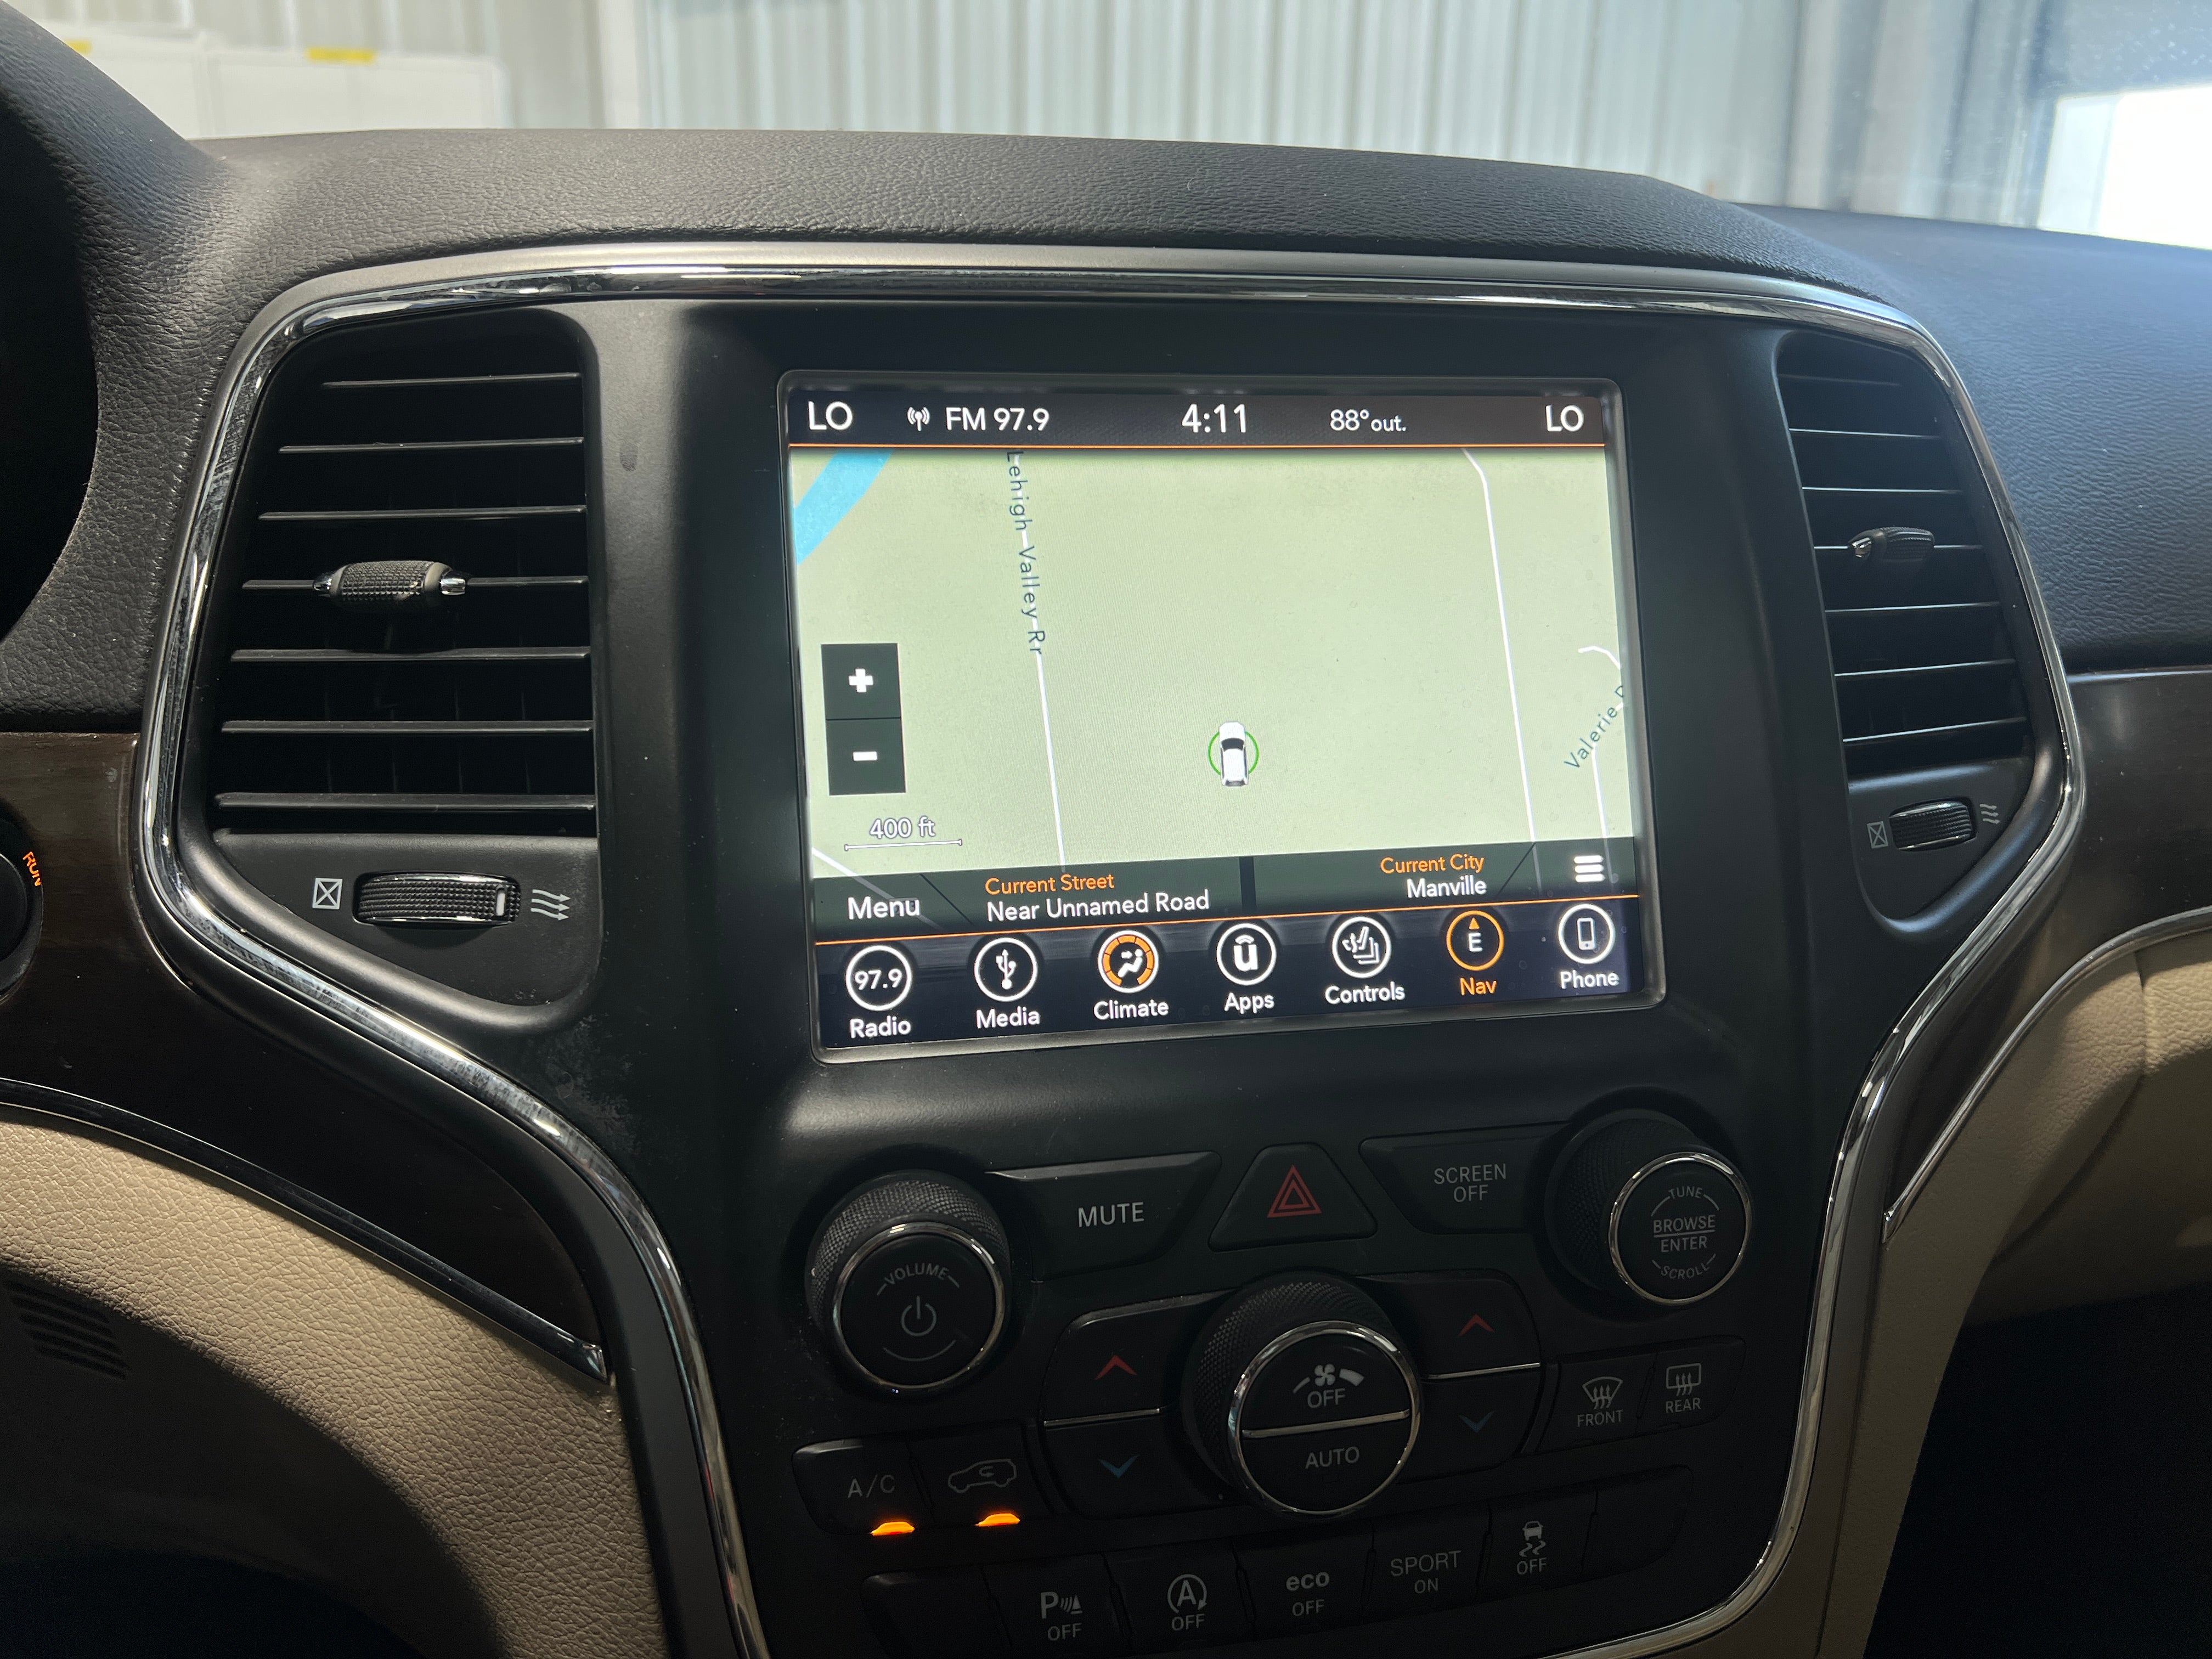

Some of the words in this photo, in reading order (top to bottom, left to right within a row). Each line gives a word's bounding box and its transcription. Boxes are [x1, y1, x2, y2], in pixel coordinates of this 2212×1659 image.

[808, 400, 853, 431] LO
[946, 407, 987, 431] FM
[993, 407, 1050, 431] 97.9
[1181, 404, 1247, 433] 4:11
[1545, 404, 1584, 432] LO
[1006, 451, 1033, 531] Lehigh
[1019, 545, 1041, 619] Valley
[1027, 630, 1046, 654] Rr
[1564, 707, 1618, 768] Valerie
[869, 819, 912, 839] 400
[918, 816, 936, 837] ft
[1380, 856, 1445, 874] Current
[1449, 853, 1485, 873] City
[985, 877, 1056, 896] Current
[1060, 874, 1115, 891] Street
[1406, 875, 1487, 898] Manville
[848, 896, 921, 921] Menu
[986, 901, 1039, 923] Near
[1046, 895, 1150, 919] Unnamed
[1155, 890, 1210, 912] Road
[854, 969, 903, 991] 97.9
[1459, 977, 1497, 996] Nav
[1560, 969, 1620, 990] Phone
[1224, 992, 1275, 1013] Apps
[1324, 982, 1406, 1005] Controls
[976, 1006, 1041, 1029] Media
[1093, 998, 1170, 1021] Climate
[849, 1018, 912, 1039] Radio
[1434, 1164, 1507, 1184] SCREEN
[1453, 1184, 1488, 1202] OFF
[1668, 1186, 1702, 1200] TUNE
[1077, 1201, 1145, 1228] MUTE
[1653, 1215, 1716, 1233] BROWSE
[1661, 1236, 1708, 1252] ENTER
[884, 1262, 949, 1285] VOLUME
[1660, 1262, 1710, 1280] SCROLL
[1307, 1388, 1346, 1408] OFF
[1665, 1398, 1701, 1413] REAR
[1577, 1410, 1623, 1427] FRONT
[1305, 1446, 1360, 1469] AUTO
[847, 1474, 895, 1499] A/C
[1390, 1550, 1462, 1577] SPORT
[1516, 1557, 1547, 1575] OFF
[1286, 1571, 1330, 1591] eco
[1414, 1578, 1439, 1594] ON
[1291, 1599, 1325, 1616] OFF
[1047, 1622, 1082, 1641] OFF
[1171, 1613, 1205, 1632] OFF
